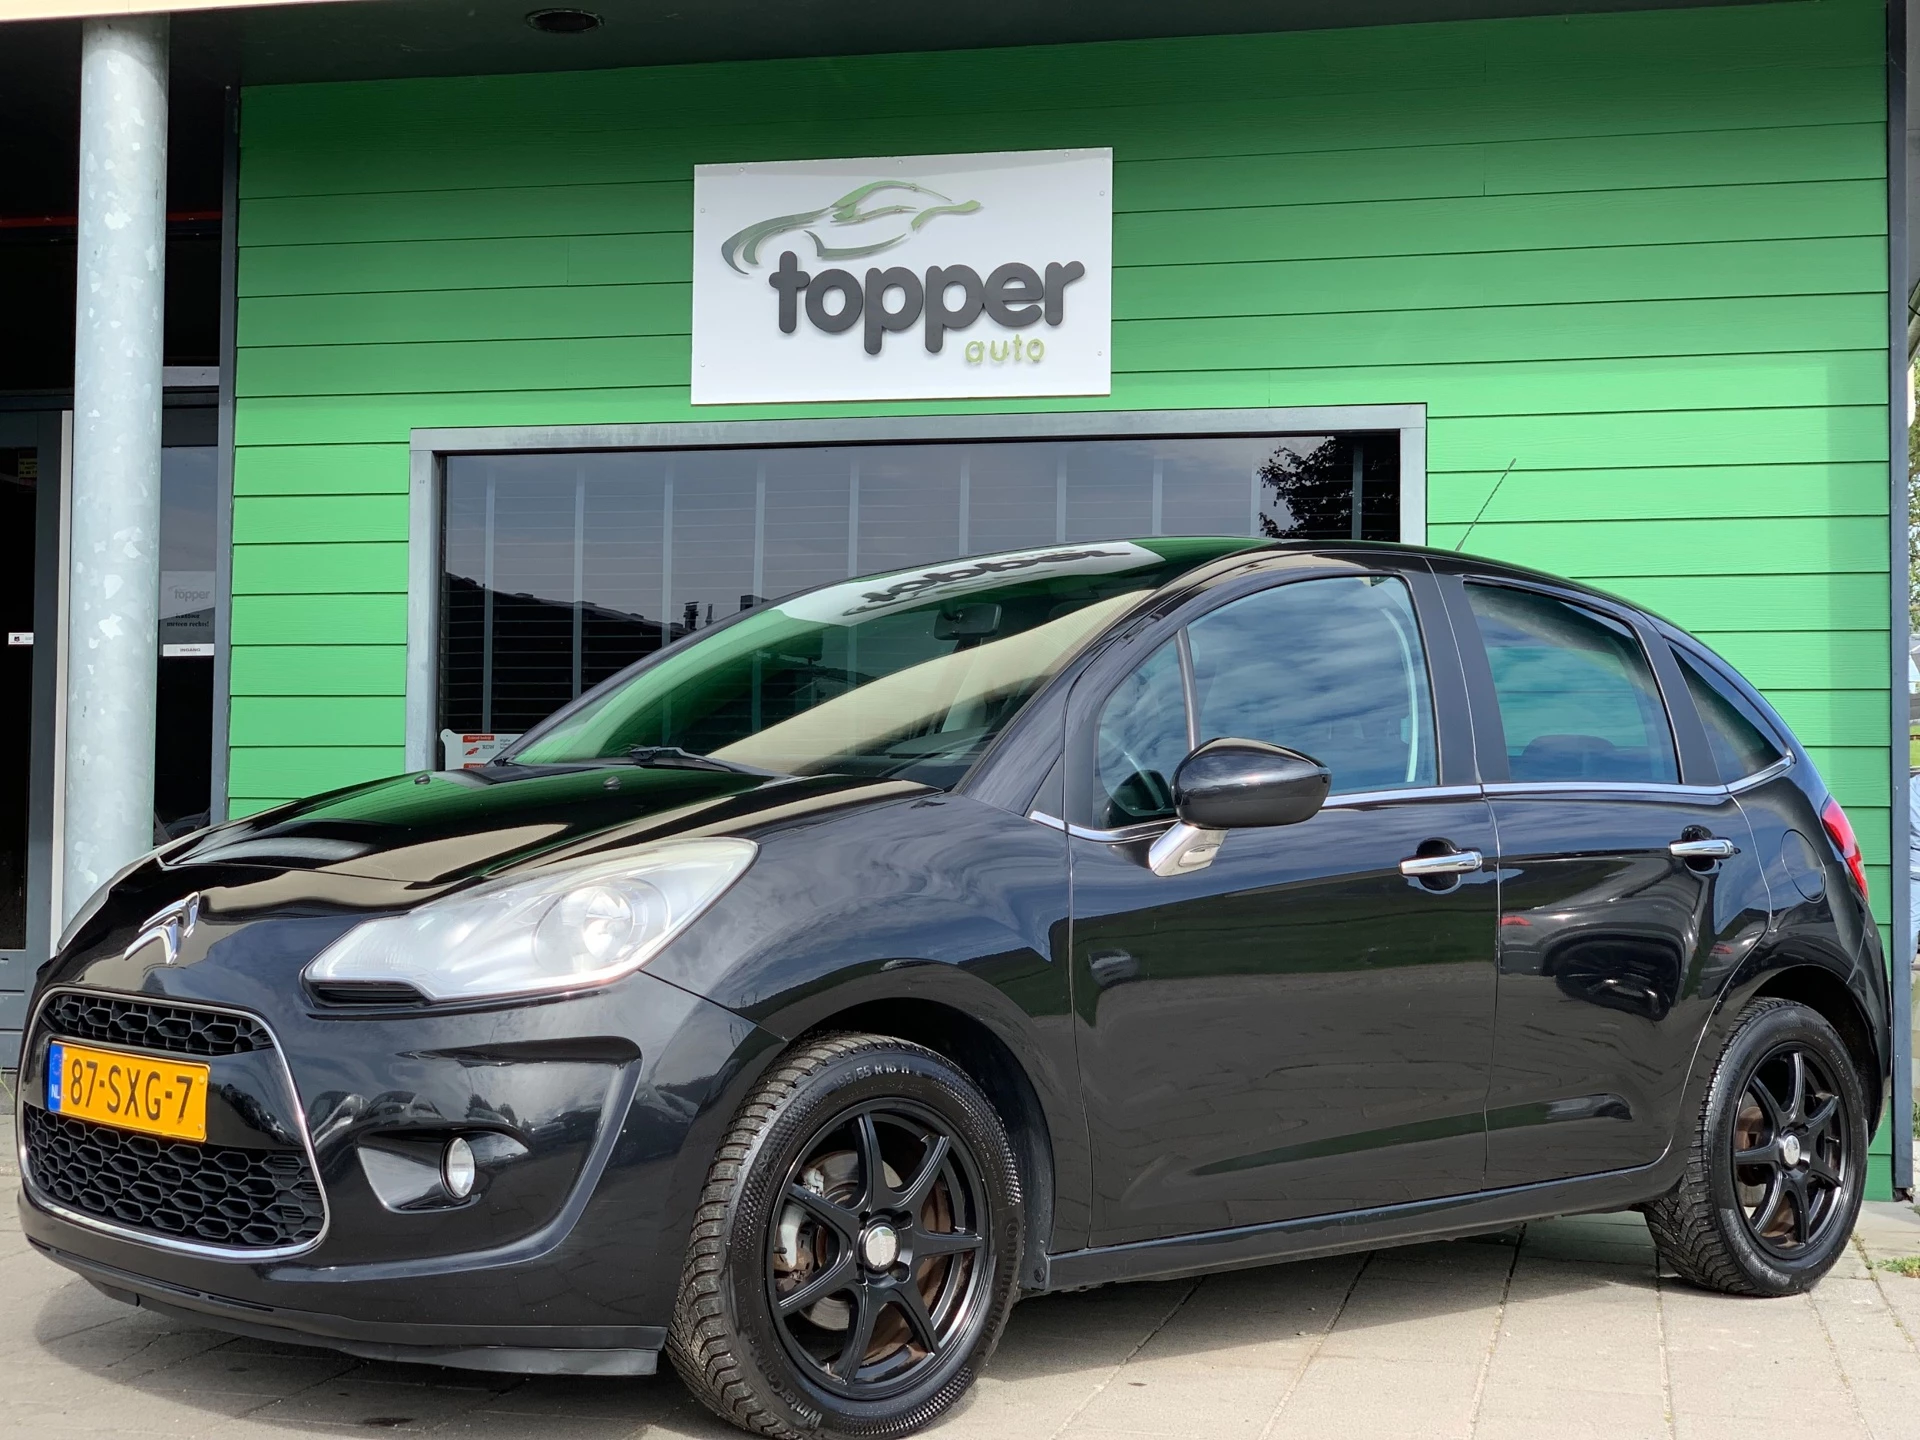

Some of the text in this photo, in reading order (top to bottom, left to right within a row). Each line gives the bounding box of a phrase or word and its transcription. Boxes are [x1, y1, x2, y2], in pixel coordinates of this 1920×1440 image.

[769, 251, 1085, 355] topper
[965, 334, 1045, 364] auto
[174, 589, 210, 601] topper
[874, 1063, 883, 1075] R
[51, 1083, 60, 1100] NL
[71, 1058, 193, 1125] 87-SXG-7
